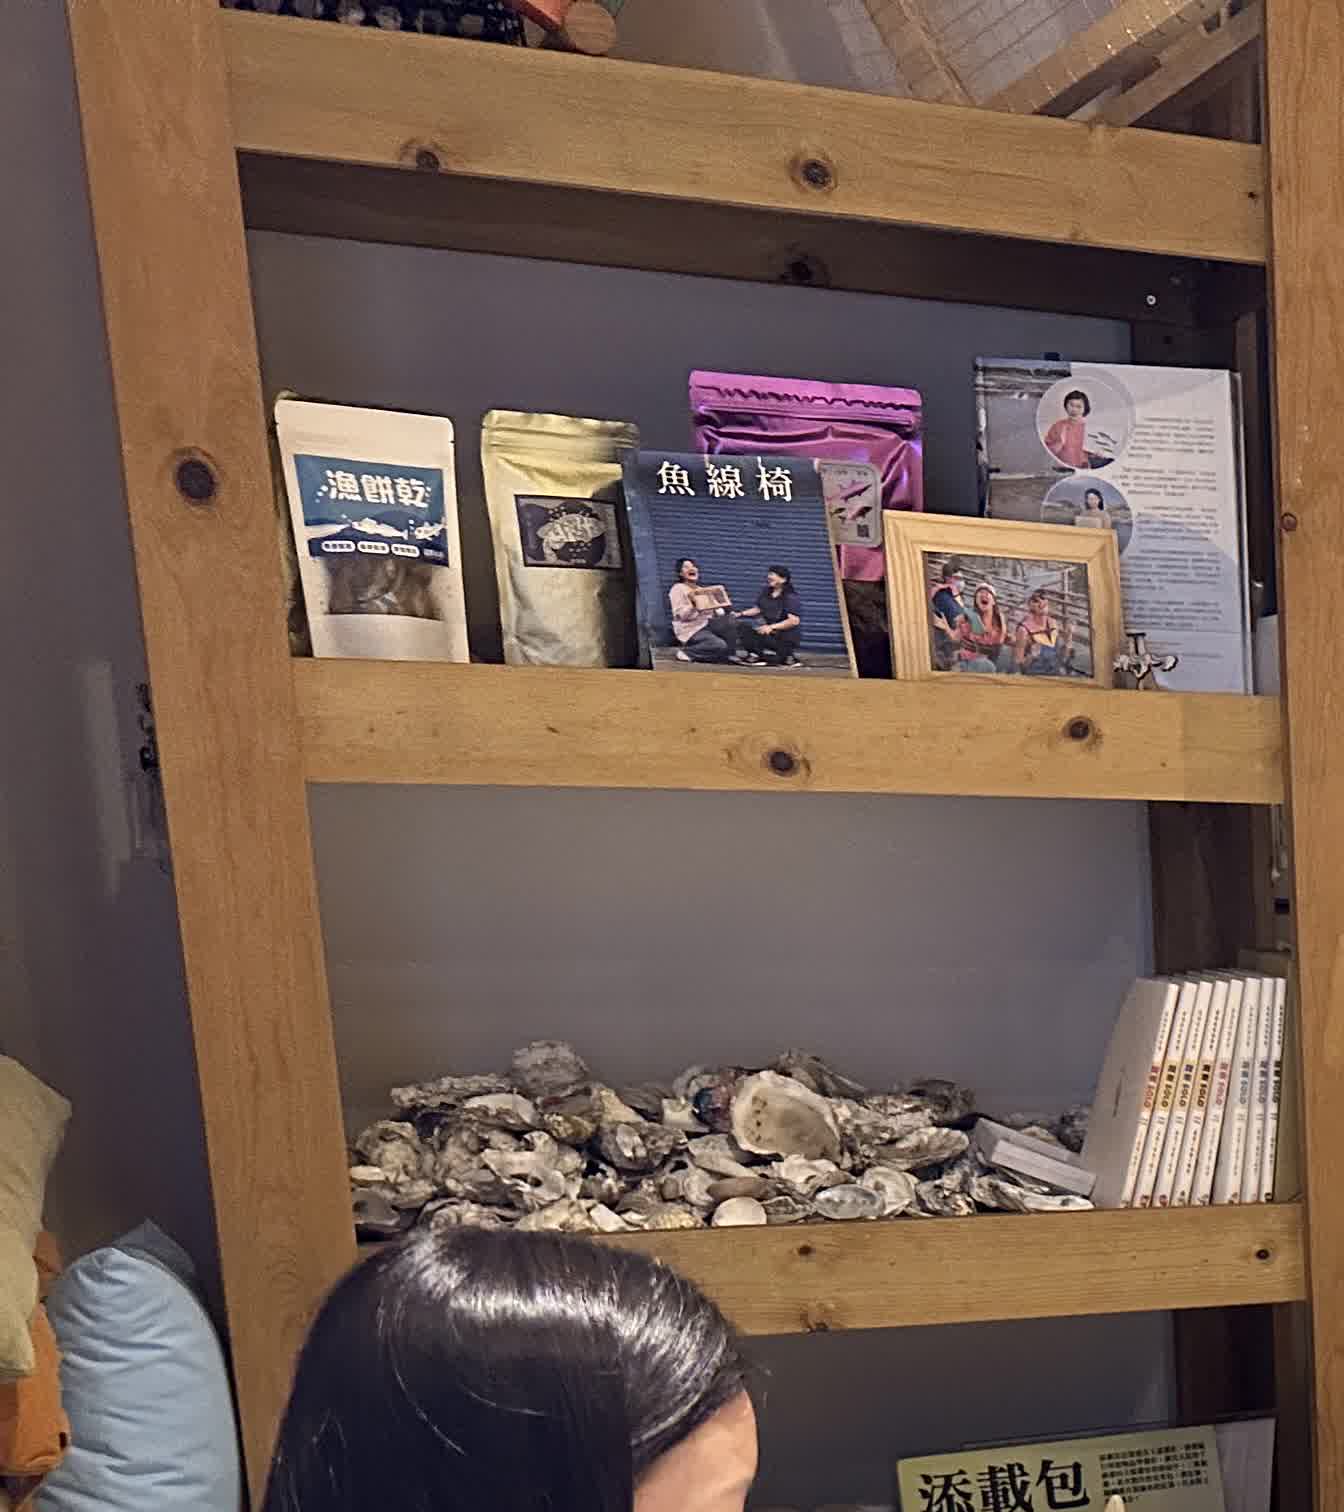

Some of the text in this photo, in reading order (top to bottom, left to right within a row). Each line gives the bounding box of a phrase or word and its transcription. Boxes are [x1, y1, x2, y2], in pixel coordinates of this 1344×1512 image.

[326, 469, 429, 509] 漁餅乾
[657, 460, 793, 502] 魚線椅
